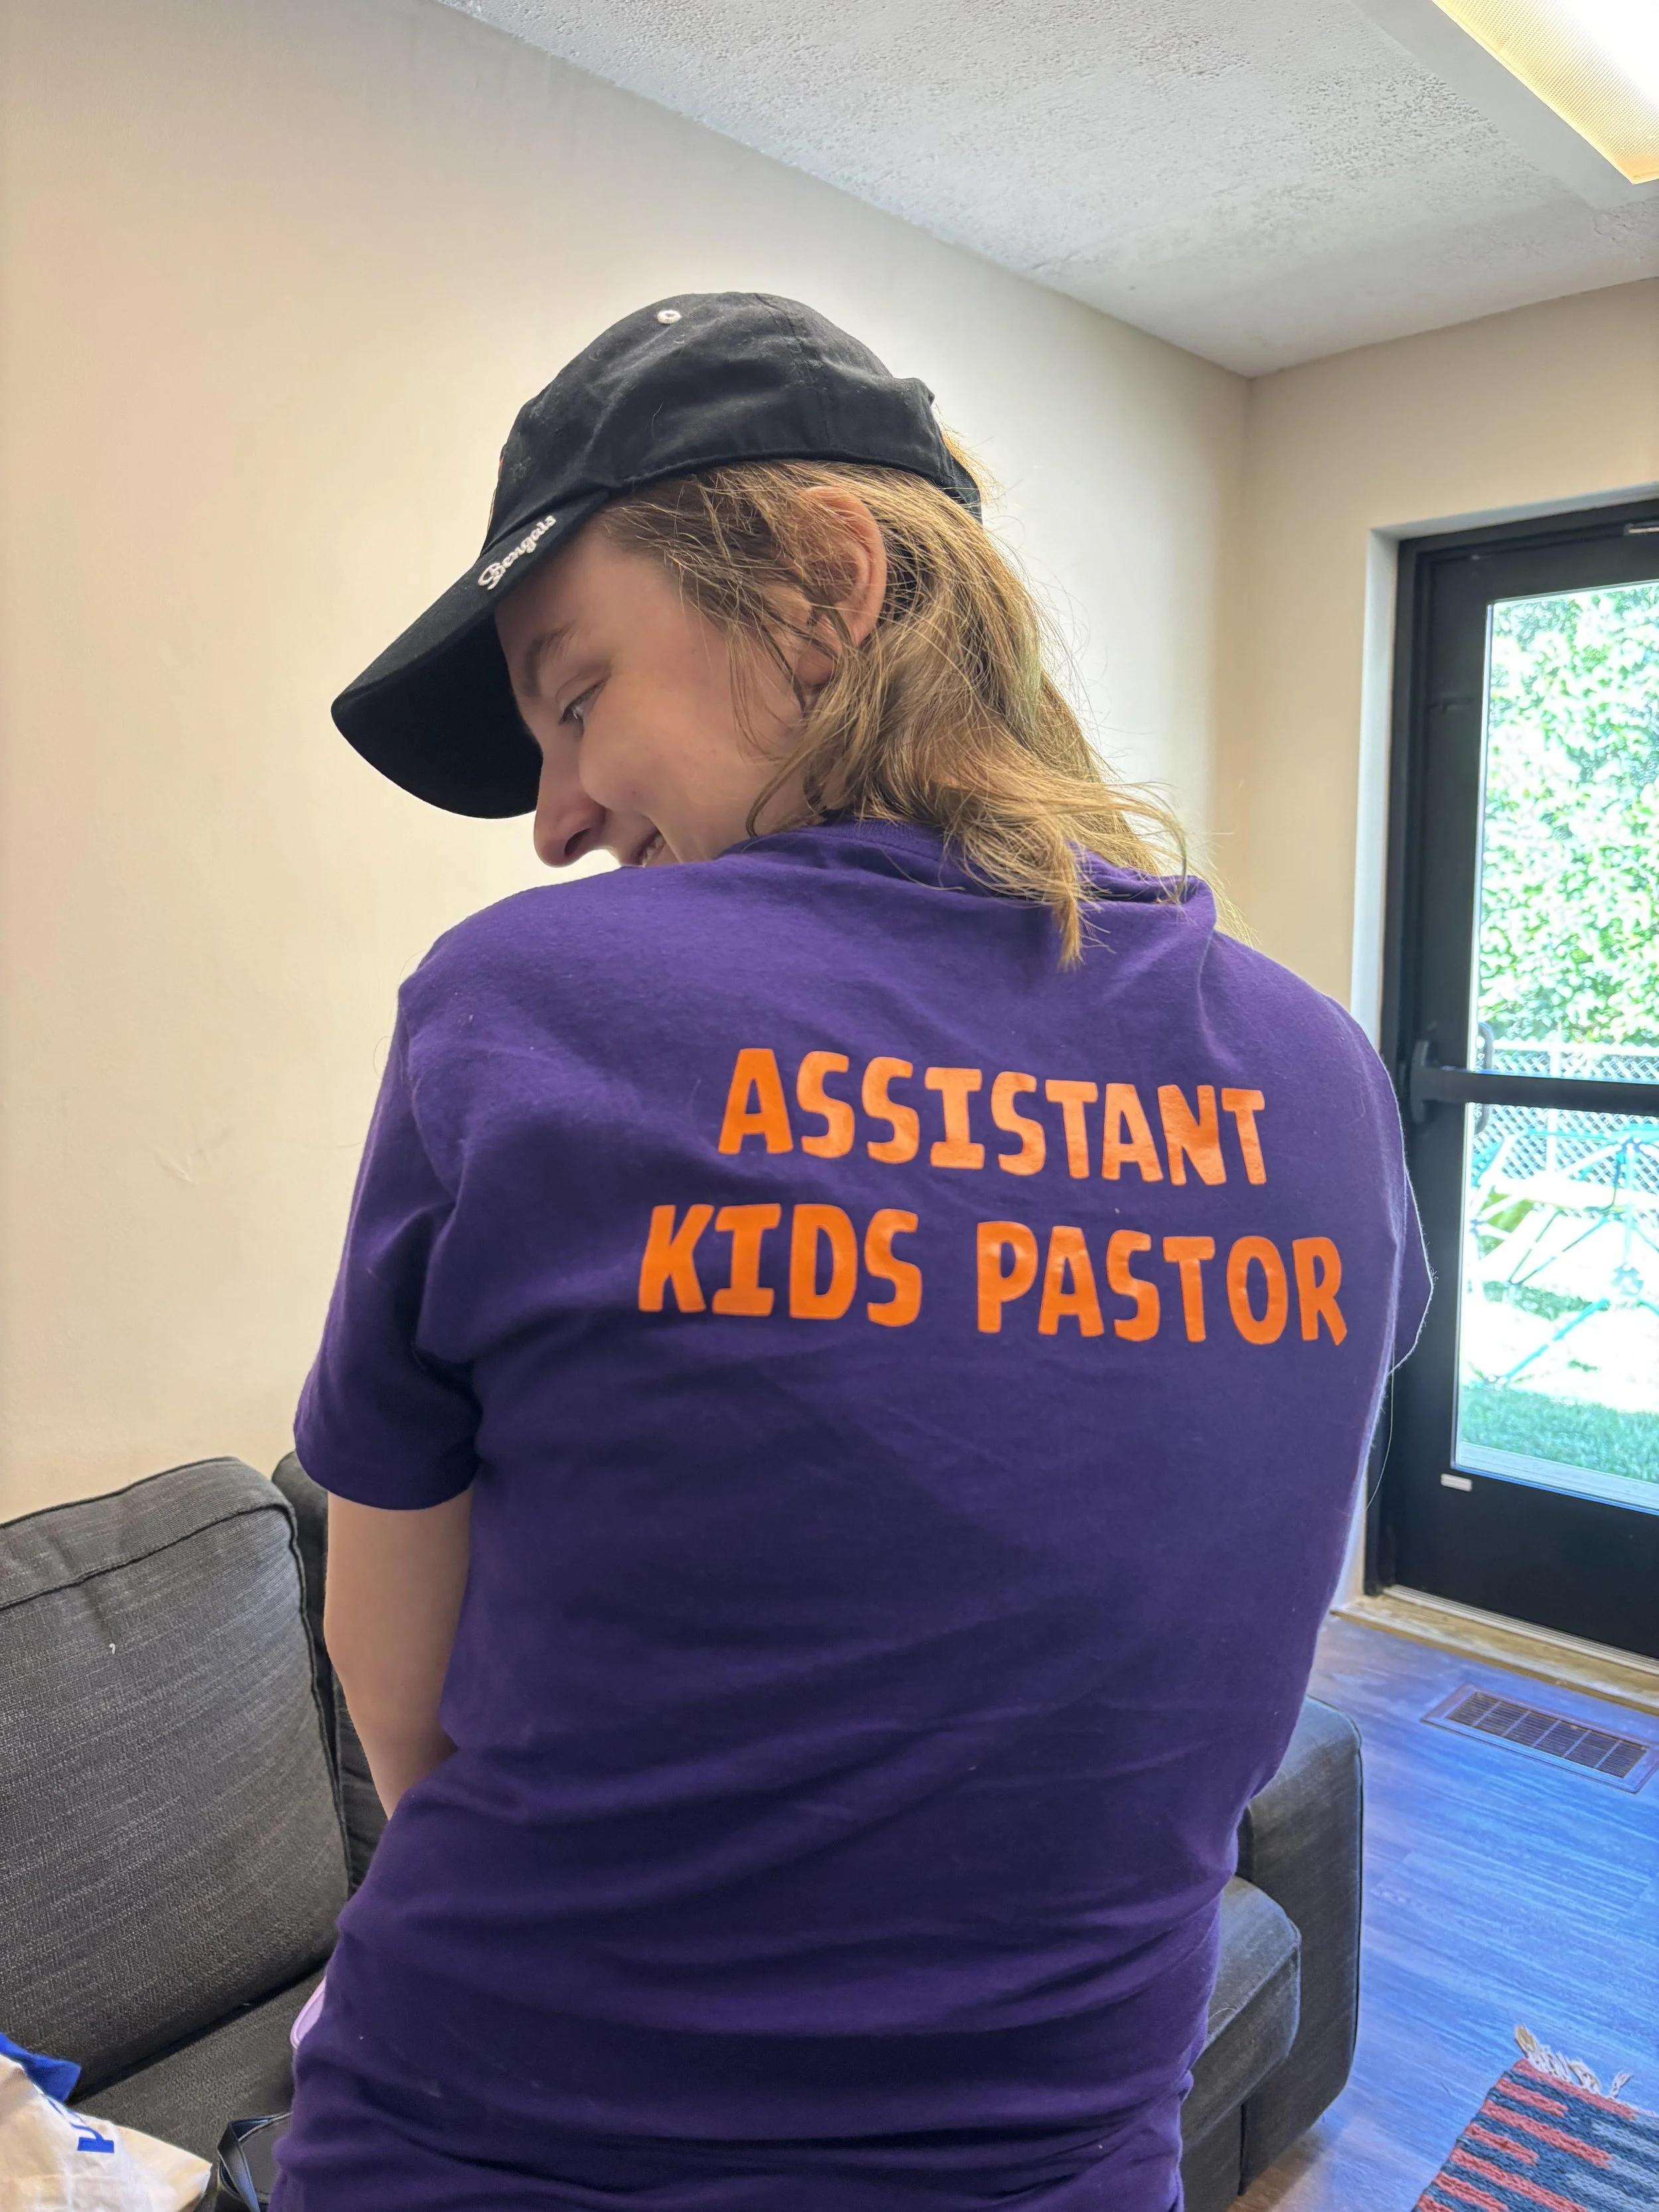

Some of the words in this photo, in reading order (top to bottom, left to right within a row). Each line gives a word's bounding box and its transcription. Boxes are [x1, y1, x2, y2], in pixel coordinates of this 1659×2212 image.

[477, 515, 557, 590] Bengals
[718, 1048, 1265, 1184] ASSISTANT
[638, 1203, 922, 1326] KIDS
[977, 1221, 1346, 1345] PASTOR
